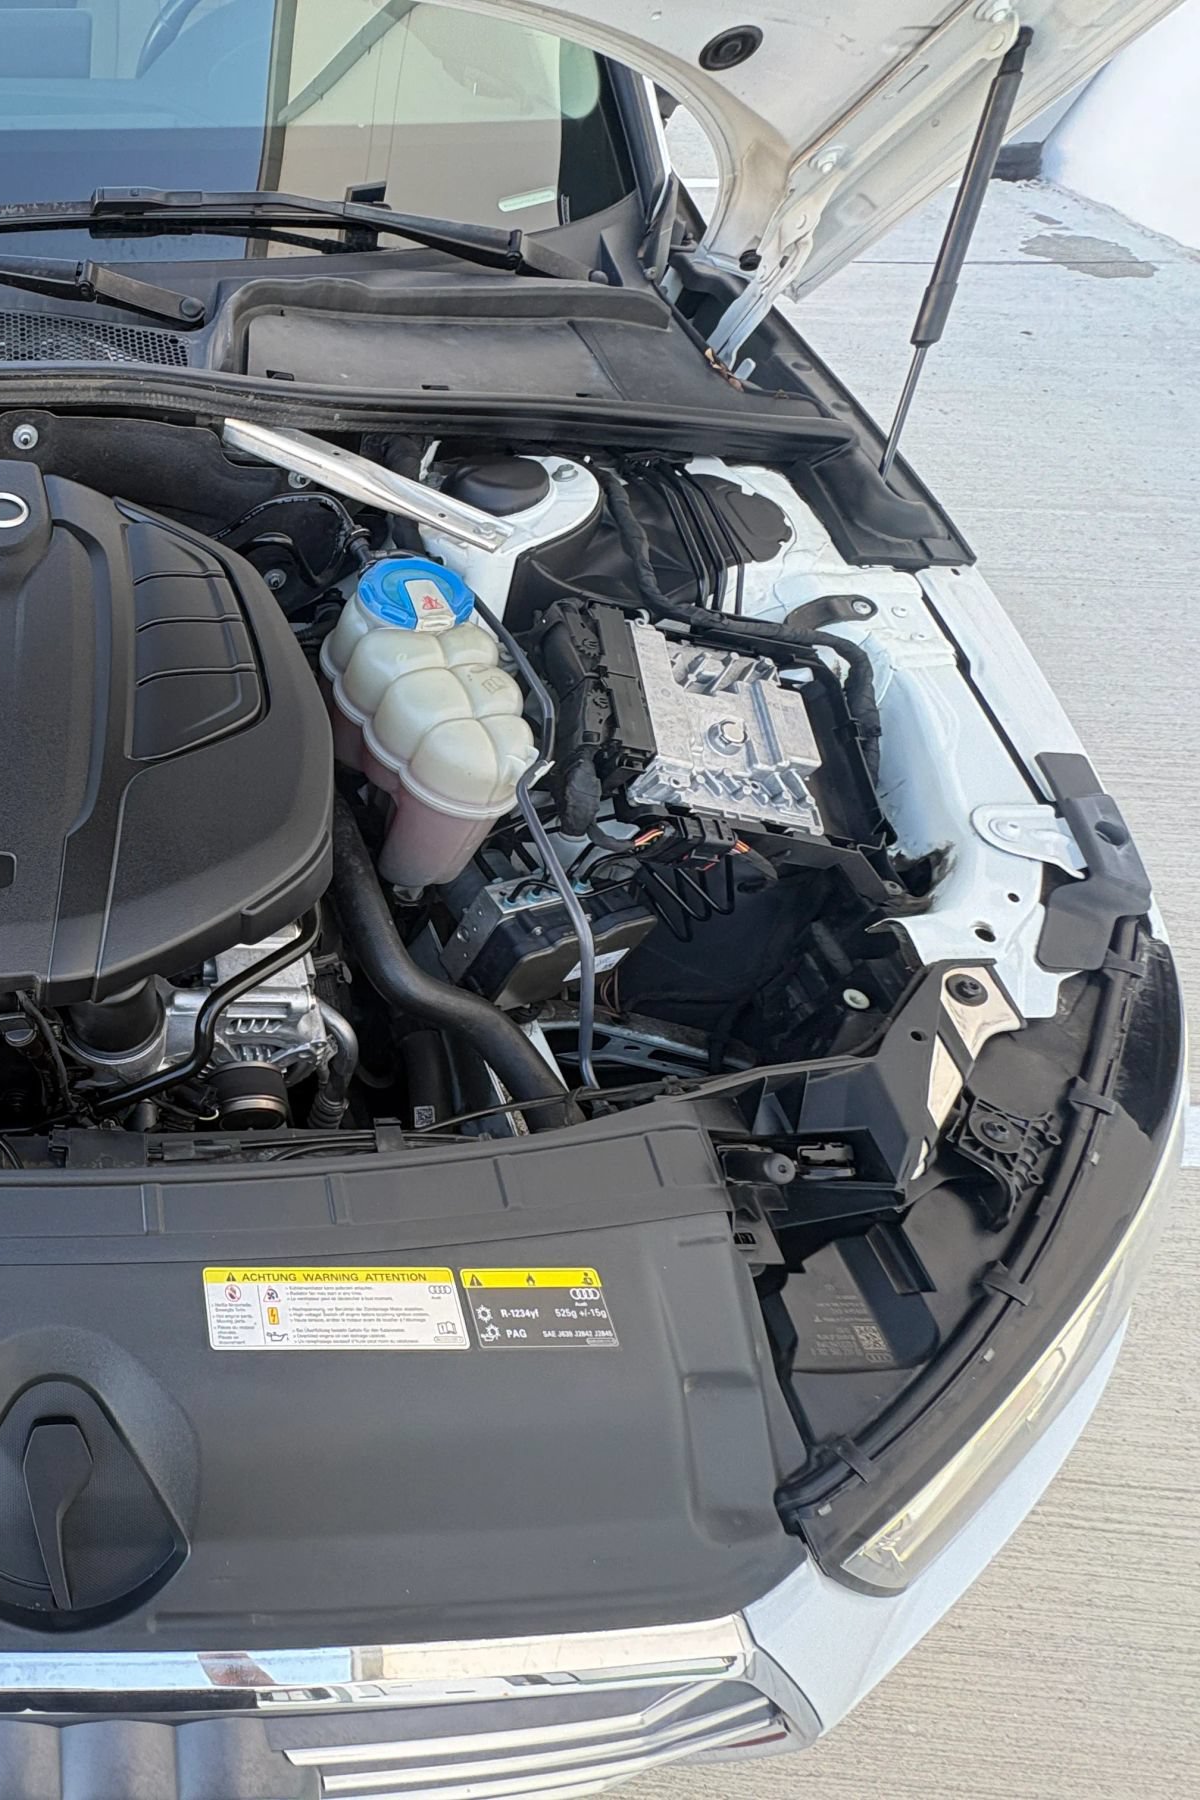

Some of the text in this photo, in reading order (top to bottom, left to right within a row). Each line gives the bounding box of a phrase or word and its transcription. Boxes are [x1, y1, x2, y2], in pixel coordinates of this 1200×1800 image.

[242, 1272, 427, 1282] ACHTUNG WARNING ATTENTION
[500, 1308, 539, 1319] R-1234yf
[554, 1308, 578, 1319] 525g
[506, 1329, 527, 1339] PAG
[542, 1329, 557, 1338] SAE
